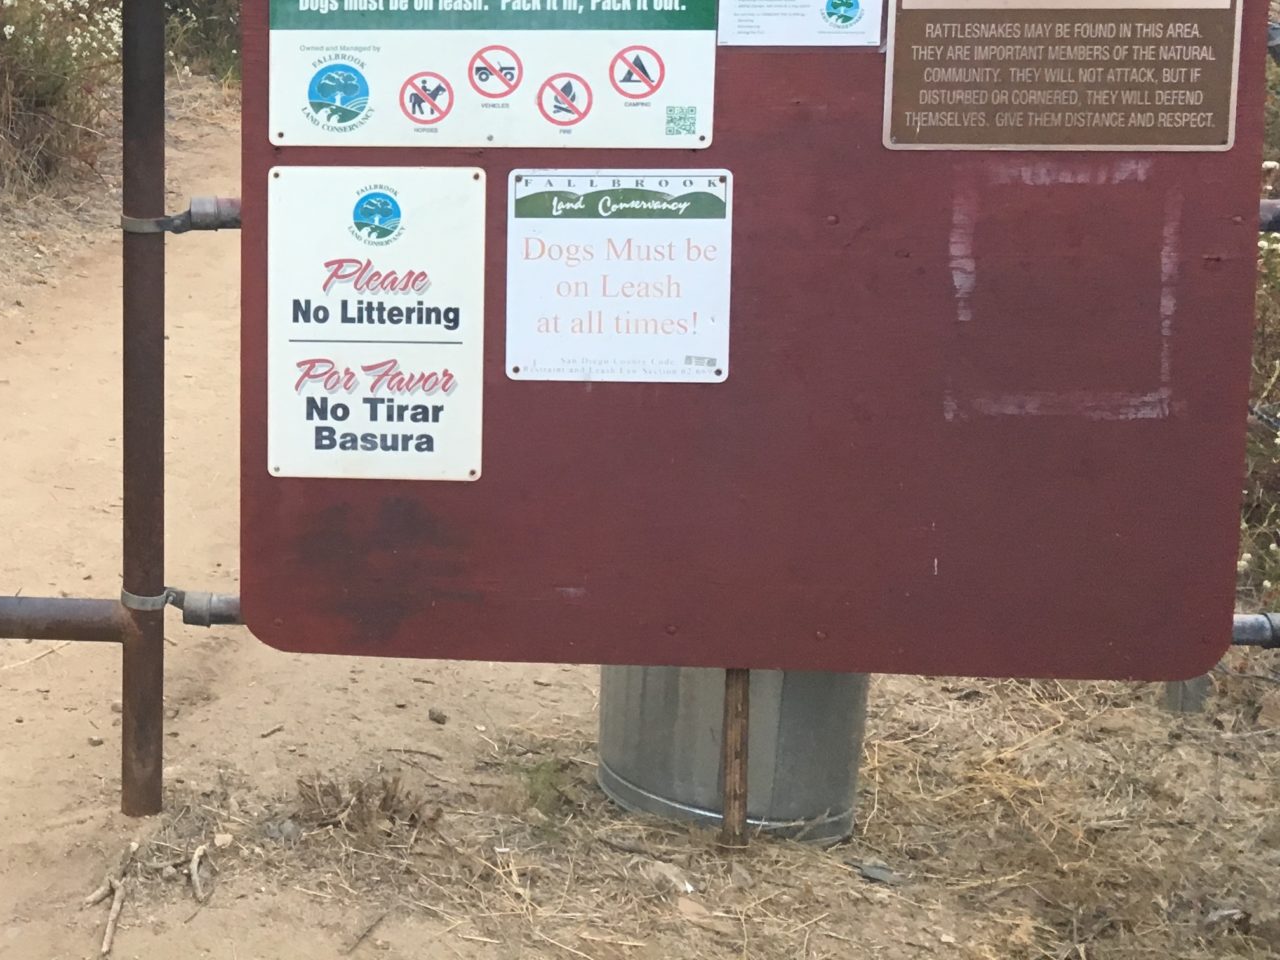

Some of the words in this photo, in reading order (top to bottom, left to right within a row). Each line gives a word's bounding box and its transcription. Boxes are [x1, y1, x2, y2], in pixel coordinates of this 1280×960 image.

[925, 23, 1021, 38] RATTLESNAKES
[1024, 23, 1052, 38] MAY
[1055, 23, 1071, 38] BE
[1074, 23, 1116, 38] FOUND
[1120, 23, 1132, 38] IN
[1135, 23, 1164, 38] THIS
[1166, 23, 1203, 38] AREA.
[311, 53, 367, 69] FALLBROOK
[911, 45, 944, 61] THEY
[946, 45, 970, 60] ARE
[974, 45, 1045, 60] IMPORTANT
[1048, 45, 1110, 61] MEMBERS
[1113, 45, 1129, 60] OF
[1132, 45, 1156, 60] THE
[1159, 45, 1216, 61] NATURAL
[924, 67, 1003, 83] COMMUNITY.
[1009, 67, 1042, 82] THEY
[1044, 67, 1075, 83] WILL
[1078, 67, 1104, 83] NOT
[1107, 67, 1158, 84] ATTACK,
[1162, 67, 1188, 83] BUT
[1190, 67, 1202, 83] IF
[919, 90, 988, 105] DISTURBED
[991, 90, 1009, 105] OR
[1011, 90, 1081, 107] CORNERED,
[1087, 90, 1118, 105] THEY
[1121, 90, 1152, 105] WILL
[1155, 90, 1203, 105] DEFEND
[301, 106, 321, 127] LAND
[321, 106, 375, 133] CONSERVANCY
[905, 112, 990, 127] THEMSELVES.
[995, 112, 1023, 127] GIVE
[1028, 112, 1062, 127] THEM
[1065, 112, 1125, 127] DISTANCE
[1127, 112, 1154, 127] AND
[1157, 112, 1216, 128] RESPECT.
[356, 183, 400, 197] FALLBROOK
[524, 178, 718, 189] FALLBROOK
[551, 196, 586, 216] Land
[598, 195, 691, 217] Conservancy
[347, 225, 363, 242] LAND
[363, 225, 407, 247] CONSERVANCY
[523, 237, 595, 268] Dogs
[606, 237, 676, 262] Must
[686, 237, 718, 262] be
[322, 258, 430, 295] Please
[556, 279, 589, 298] on
[601, 274, 682, 298] Leash
[292, 299, 330, 324] No
[340, 299, 460, 330] Littering
[536, 313, 560, 334] at
[570, 310, 603, 334] all
[614, 311, 699, 336] times!
[295, 358, 358, 393] Por
[361, 358, 456, 394] Favor
[306, 396, 350, 422] No
[362, 397, 445, 423] Tirar
[314, 425, 435, 453] Basura
